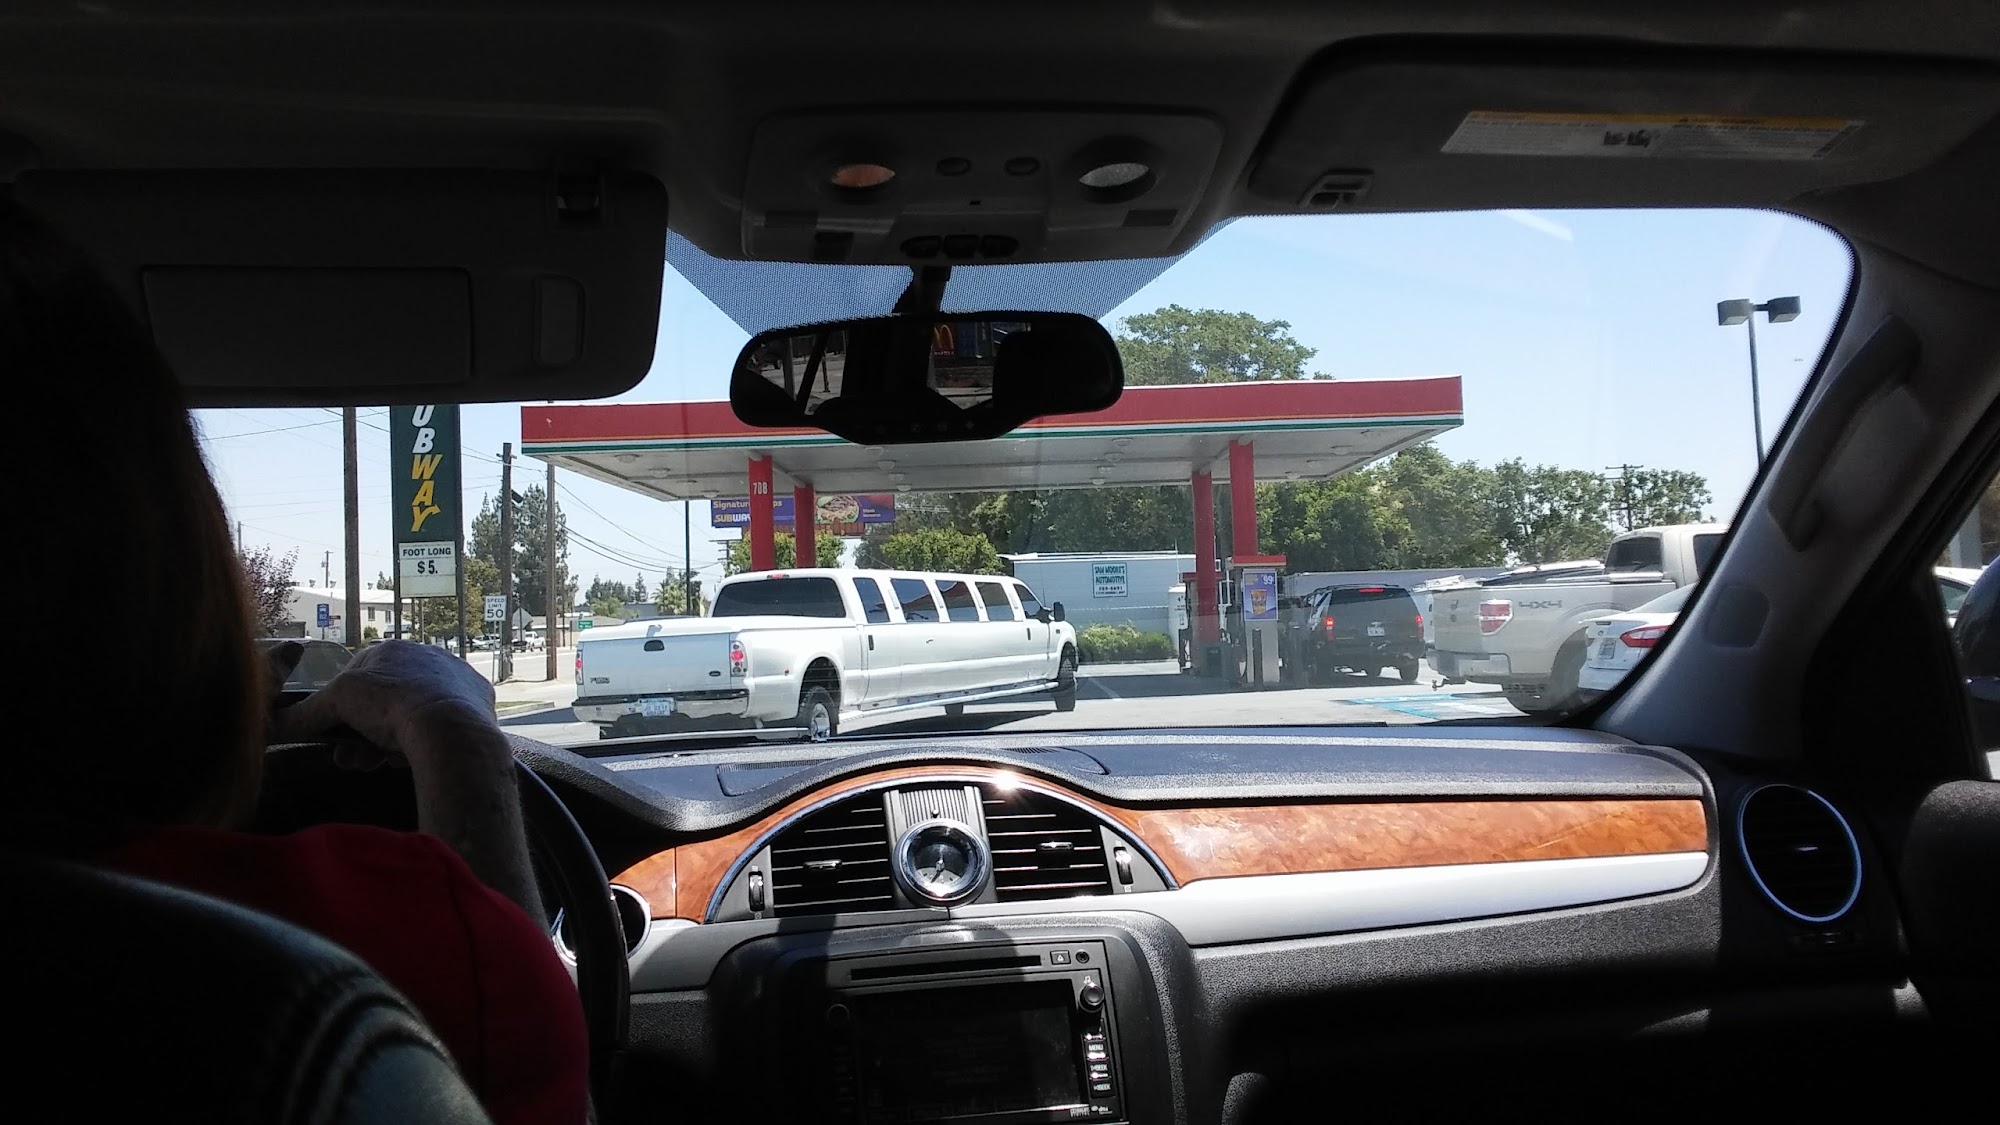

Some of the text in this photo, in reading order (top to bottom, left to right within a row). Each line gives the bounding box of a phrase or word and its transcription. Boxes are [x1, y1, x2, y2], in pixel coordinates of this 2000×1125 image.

[411, 405, 442, 532] UBWAY
[752, 482, 768, 495] 708
[713, 501, 749, 511] Signatur
[402, 547, 451, 557] FOOT LONG
[486, 608, 504, 619] 50
